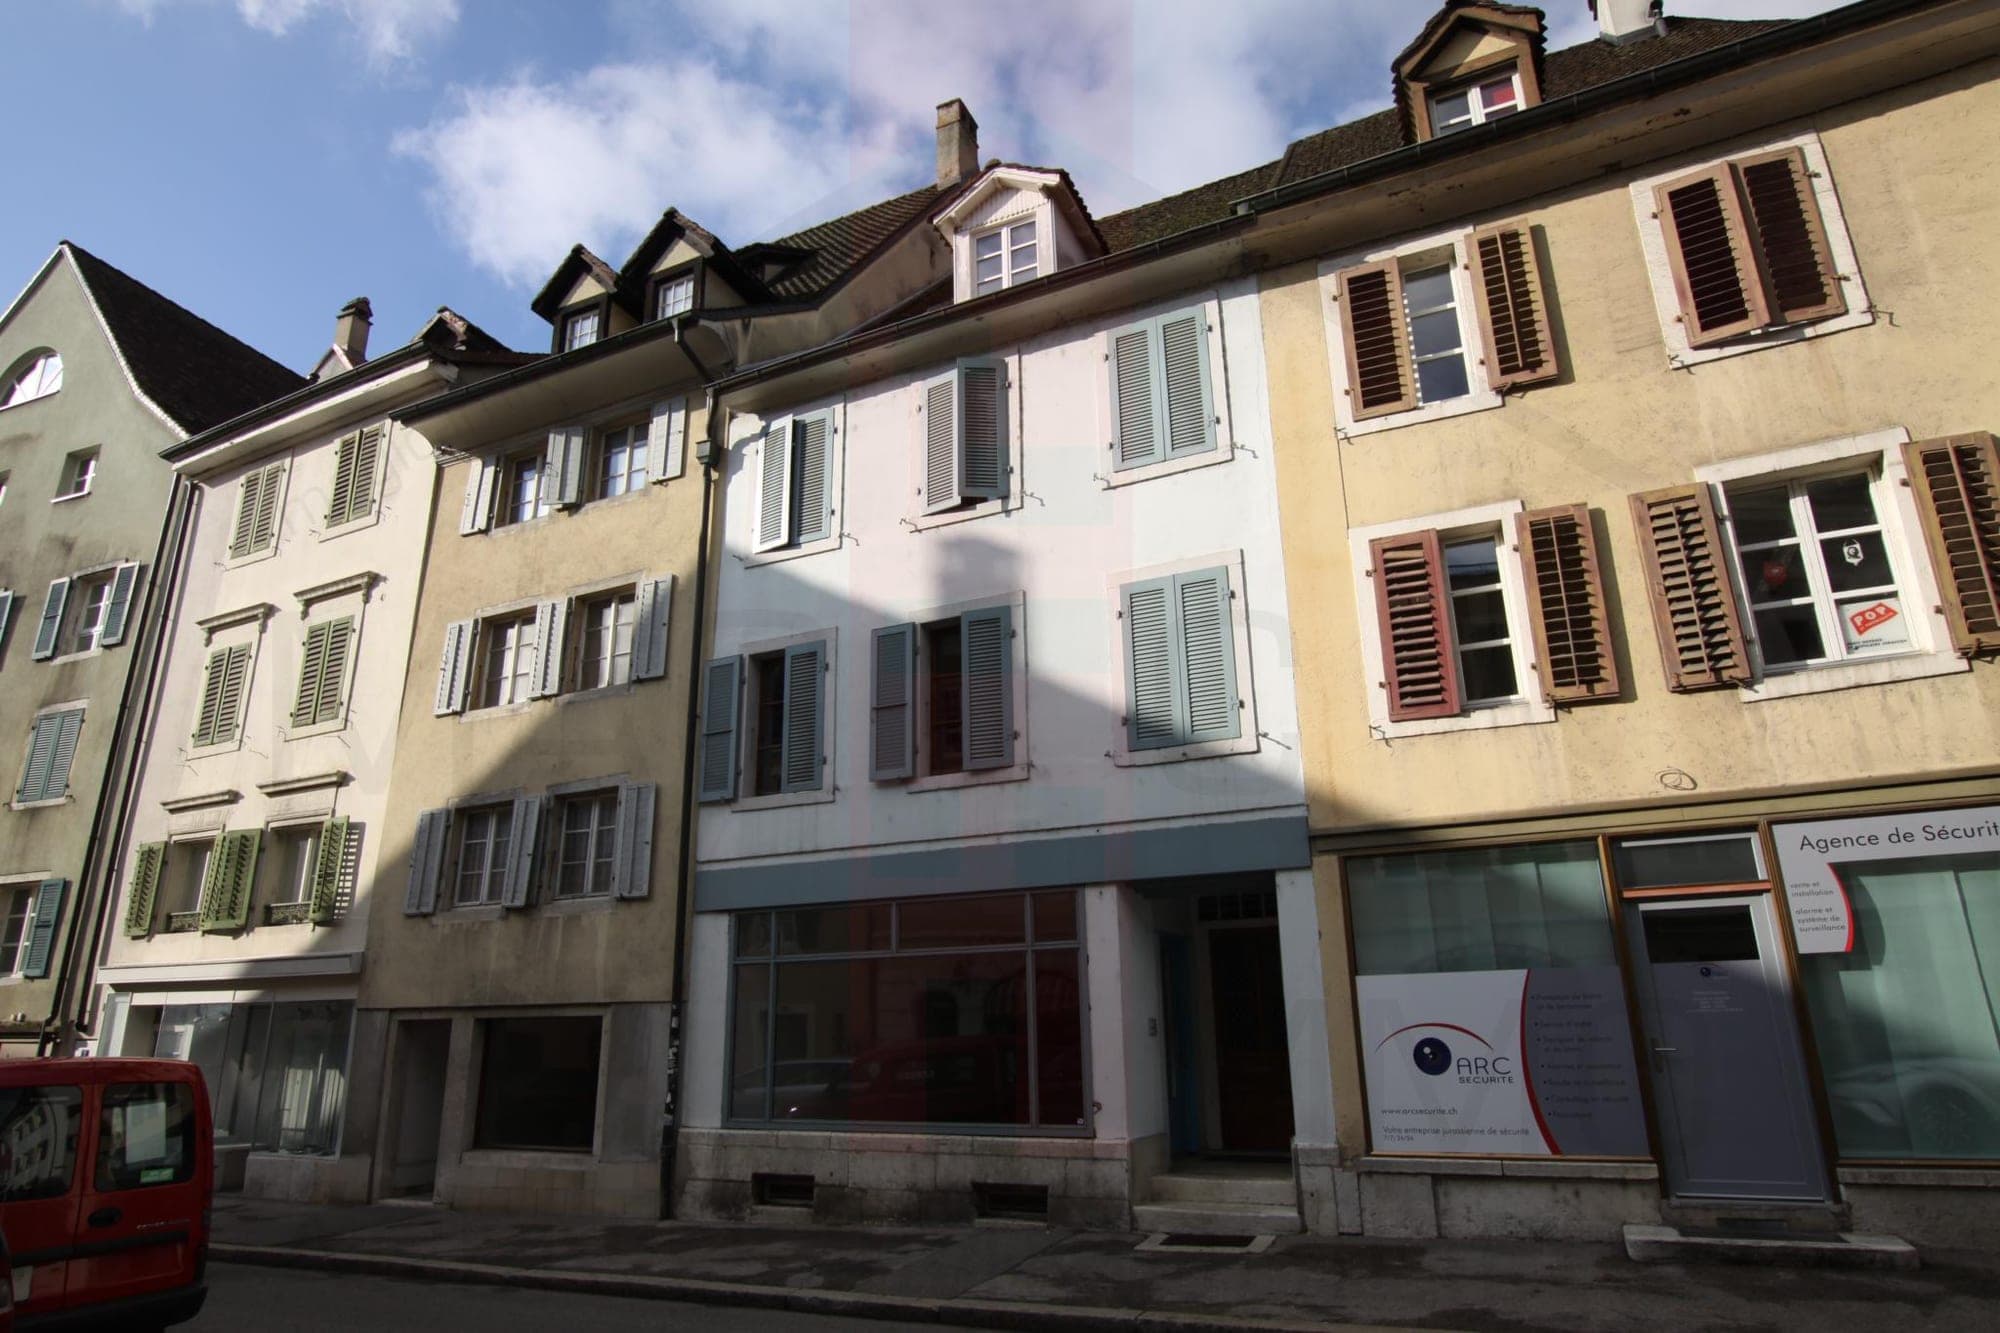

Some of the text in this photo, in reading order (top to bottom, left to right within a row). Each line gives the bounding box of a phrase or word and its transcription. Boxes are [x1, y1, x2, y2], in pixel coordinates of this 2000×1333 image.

[1800, 835, 1880, 853] Agence
[1888, 827, 1914, 844] de
[1791, 888, 1834, 896] installation
[1799, 923, 1846, 932] surveillance
[1457, 1057, 1512, 1076] ARC
[1487, 1127, 1498, 1135] de
